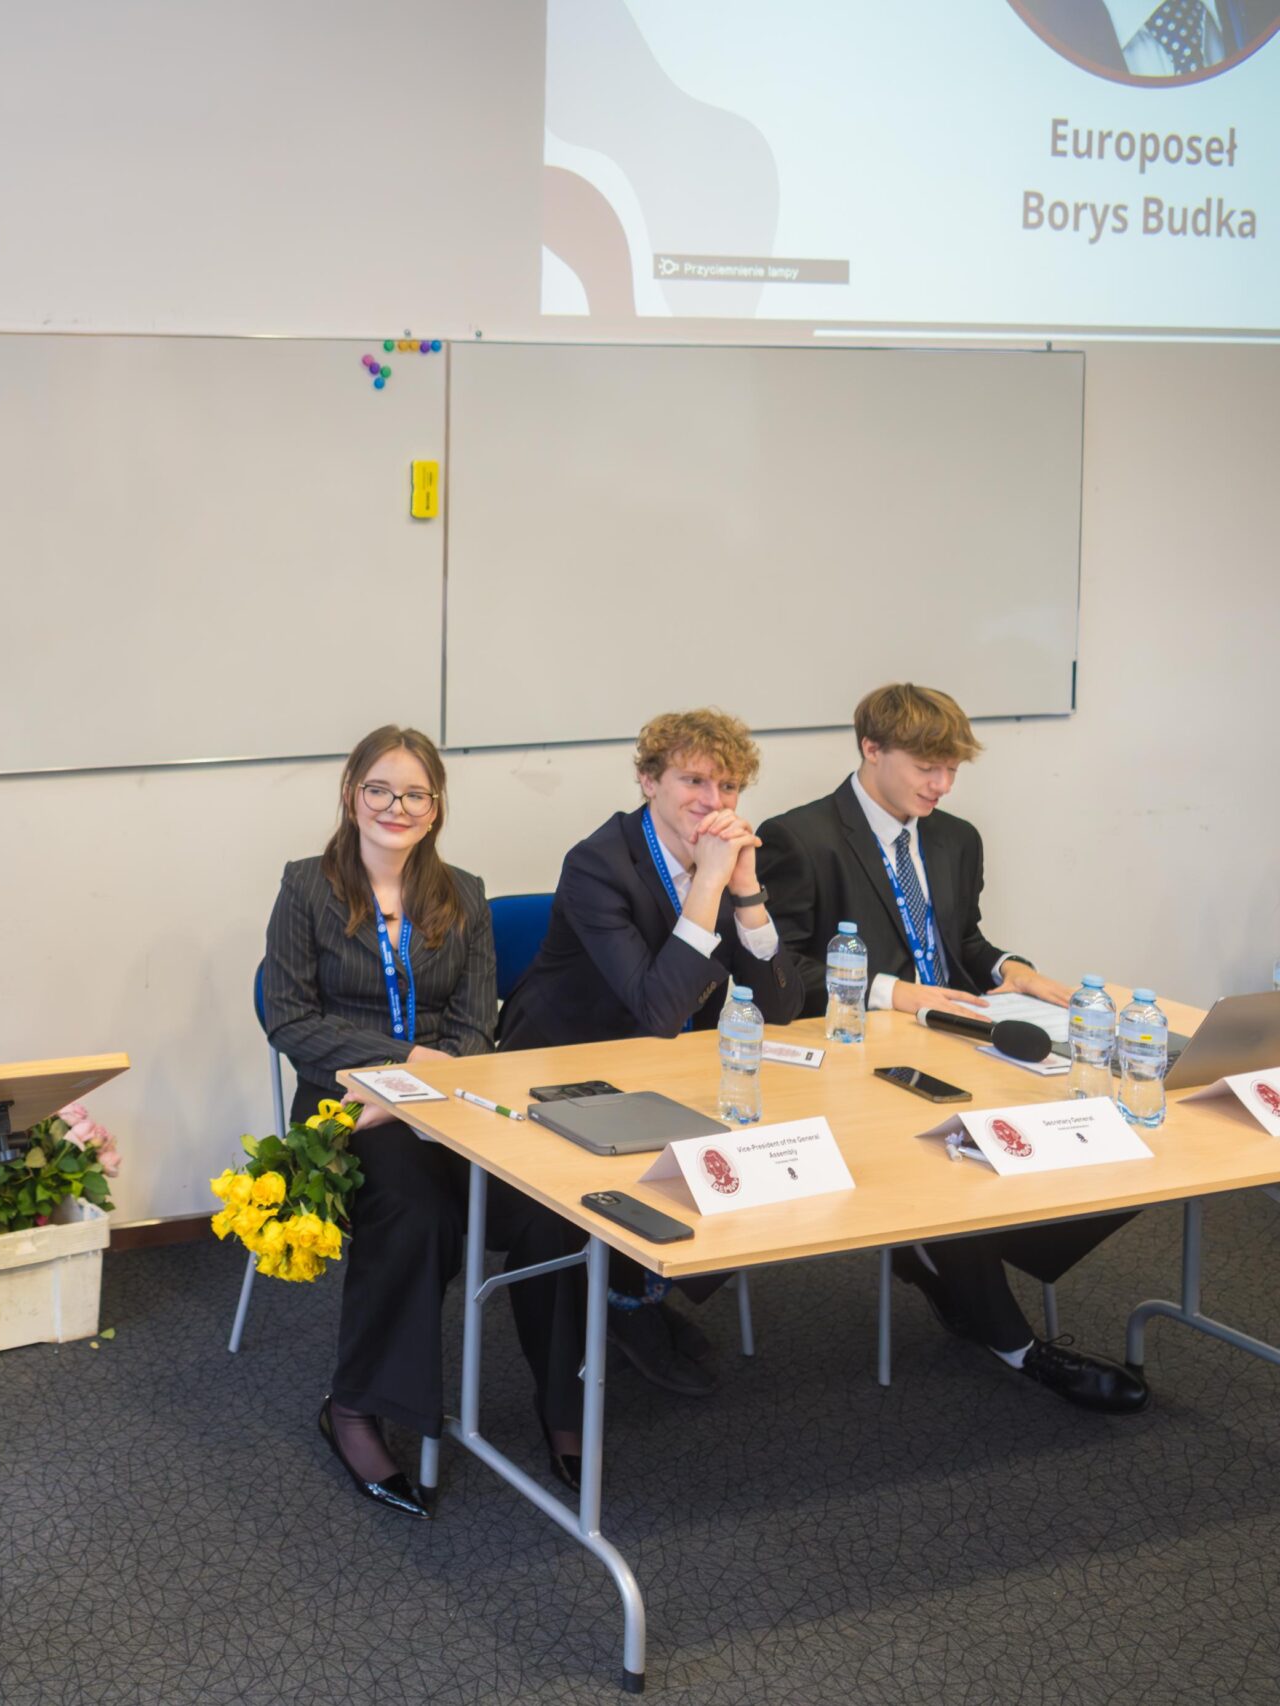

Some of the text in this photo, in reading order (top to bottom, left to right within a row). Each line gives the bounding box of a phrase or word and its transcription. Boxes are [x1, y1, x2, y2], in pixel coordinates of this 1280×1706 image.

[1050, 118, 1238, 174] Europoseł
[1022, 190, 1257, 245] Borys Budka
[767, 266, 800, 280] lampy
[737, 1134, 819, 1153] Vice-President of the General
[769, 1149, 798, 1158] Assembly
